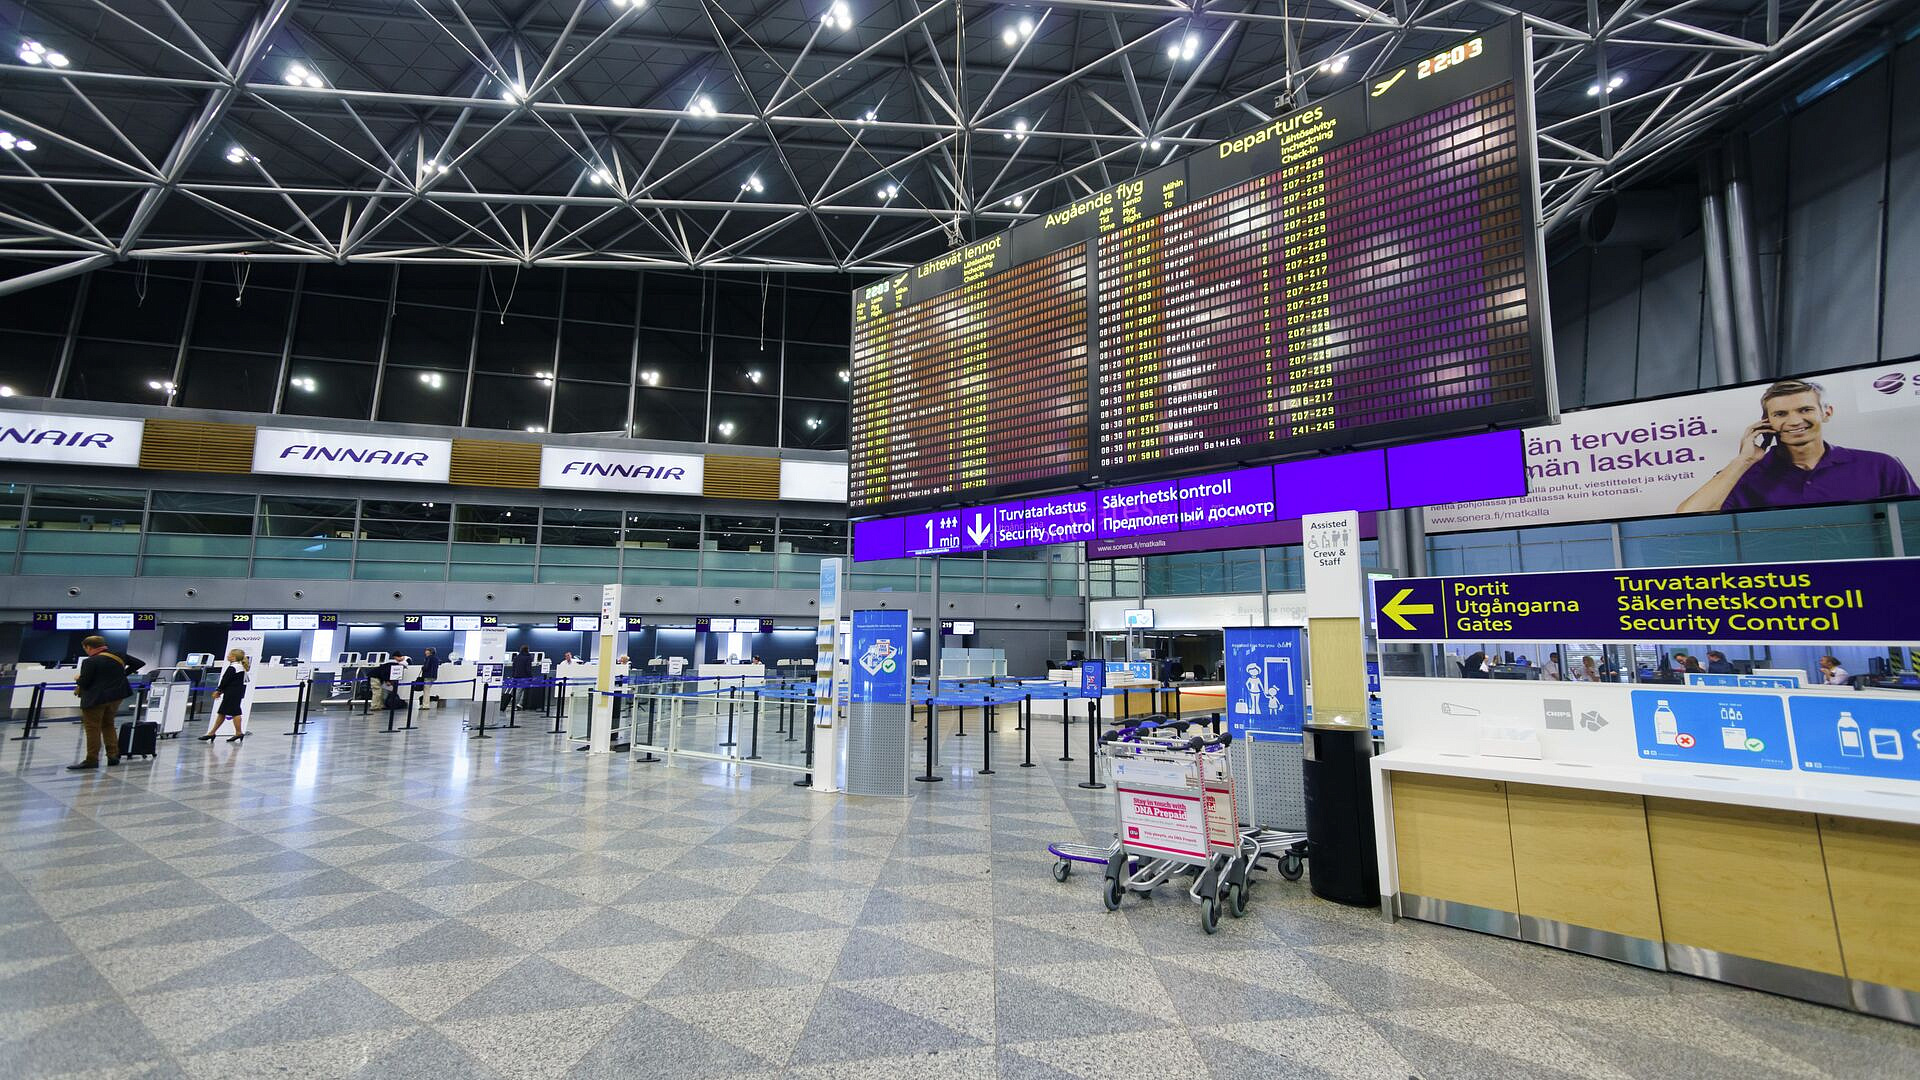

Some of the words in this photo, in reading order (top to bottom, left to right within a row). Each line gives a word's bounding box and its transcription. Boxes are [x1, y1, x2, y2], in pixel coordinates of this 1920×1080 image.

[1417, 37, 1483, 79] 22:03
[1219, 106, 1323, 159] Departures
[1280, 118, 1336, 146] Lähtöselvitys
[1281, 129, 1334, 155] Incheckning
[1281, 145, 1319, 164] Check-in
[1281, 156, 1324, 178] 207-229
[1044, 192, 1112, 228] Avgående
[1116, 180, 1144, 200] flyg
[1099, 206, 1114, 217] Aika
[1122, 196, 1142, 208] Lento
[1163, 220, 1183, 234] Rome
[1282, 169, 1324, 192] 207-229
[1163, 200, 1173, 209] To
[1099, 215, 1110, 225] Tid
[1122, 212, 1142, 225] Flight
[1163, 229, 1193, 246] Zurich
[1282, 183, 1325, 205] 207-229
[1099, 222, 1115, 233] Time
[1164, 241, 1193, 258] London
[1283, 197, 1325, 218] 201-203
[1164, 253, 1194, 271] Bergen
[1283, 211, 1326, 232] 207-229
[917, 251, 962, 278] Lähtevät
[964, 236, 1001, 260] lennot
[1164, 267, 1189, 282] Milan
[1284, 224, 1326, 245] 207-229
[1164, 278, 1194, 294] Munich
[1284, 237, 1327, 258] 207-229
[1165, 290, 1195, 306] London
[1199, 276, 1241, 296] Heathrow
[1285, 251, 1328, 271] 207-229
[1286, 278, 1329, 297] 207-229
[1165, 328, 1196, 343] Berlin
[1286, 292, 1329, 311] 207-229
[1166, 337, 1211, 355] Frankfurt
[1287, 306, 1330, 325] 207-229
[1287, 320, 1331, 338] 207-229
[1288, 334, 1331, 352] 207-229
[1166, 381, 1187, 393] Oslo
[1288, 348, 1332, 366] 207-229
[1167, 387, 1218, 407] Copenhagen
[1289, 363, 1332, 380] 207-229
[1167, 400, 1219, 419] Gothenburg
[1289, 377, 1333, 394] 207-229
[1167, 418, 1193, 430] Vaasa
[1168, 429, 1204, 444] Hamburg
[1290, 405, 1334, 421] 207-229
[1571, 415, 1718, 451] terveisiä.
[0, 427, 113, 448] NAIR
[1168, 443, 1199, 455] London
[1203, 435, 1241, 450] Gatwick
[1291, 420, 1335, 435] 241-245
[280, 444, 429, 467] FINNAIR
[1590, 447, 1705, 473] laskua.
[561, 461, 686, 481] FINNAIR
[1549, 482, 1582, 493] puhut,
[1584, 477, 1641, 489] viestittelet
[1644, 476, 1655, 485] ja
[1657, 471, 1695, 483] käytät
[1102, 478, 1232, 510] Säkerhetskontroll
[1508, 498, 1517, 506] ja
[1567, 490, 1589, 499] kuin
[1591, 487, 1642, 497] kotonasi.
[999, 501, 1087, 521] Turvatarkastus
[1103, 506, 1204, 533] Предполетный
[1208, 501, 1275, 521] досмотр
[1431, 508, 1550, 525] www.sonera.fi/matkalla
[925, 519, 933, 548] 1
[999, 526, 1046, 542] Security
[1048, 518, 1095, 537] Control
[1311, 520, 1347, 529] Assisted
[939, 533, 960, 548] min
[1097, 539, 1166, 552] www.sonera.fi/matkalla
[1313, 550, 1336, 558] Crew
[1319, 557, 1341, 567] Staff
[1454, 581, 1509, 597] Portit
[1614, 571, 1811, 592] Turvatarkastus
[1455, 597, 1580, 616] Utgångarna
[1617, 589, 1864, 612] Säkerhetskontroll
[1456, 617, 1513, 633] Gates
[1619, 614, 1720, 635] Security
[1728, 612, 1839, 632] Control
[1133, 797, 1146, 806] Stay
[1155, 800, 1172, 809] touch
[1172, 801, 1187, 811] with
[1135, 805, 1154, 815] DNA
[1154, 807, 1187, 820] Prepaid
